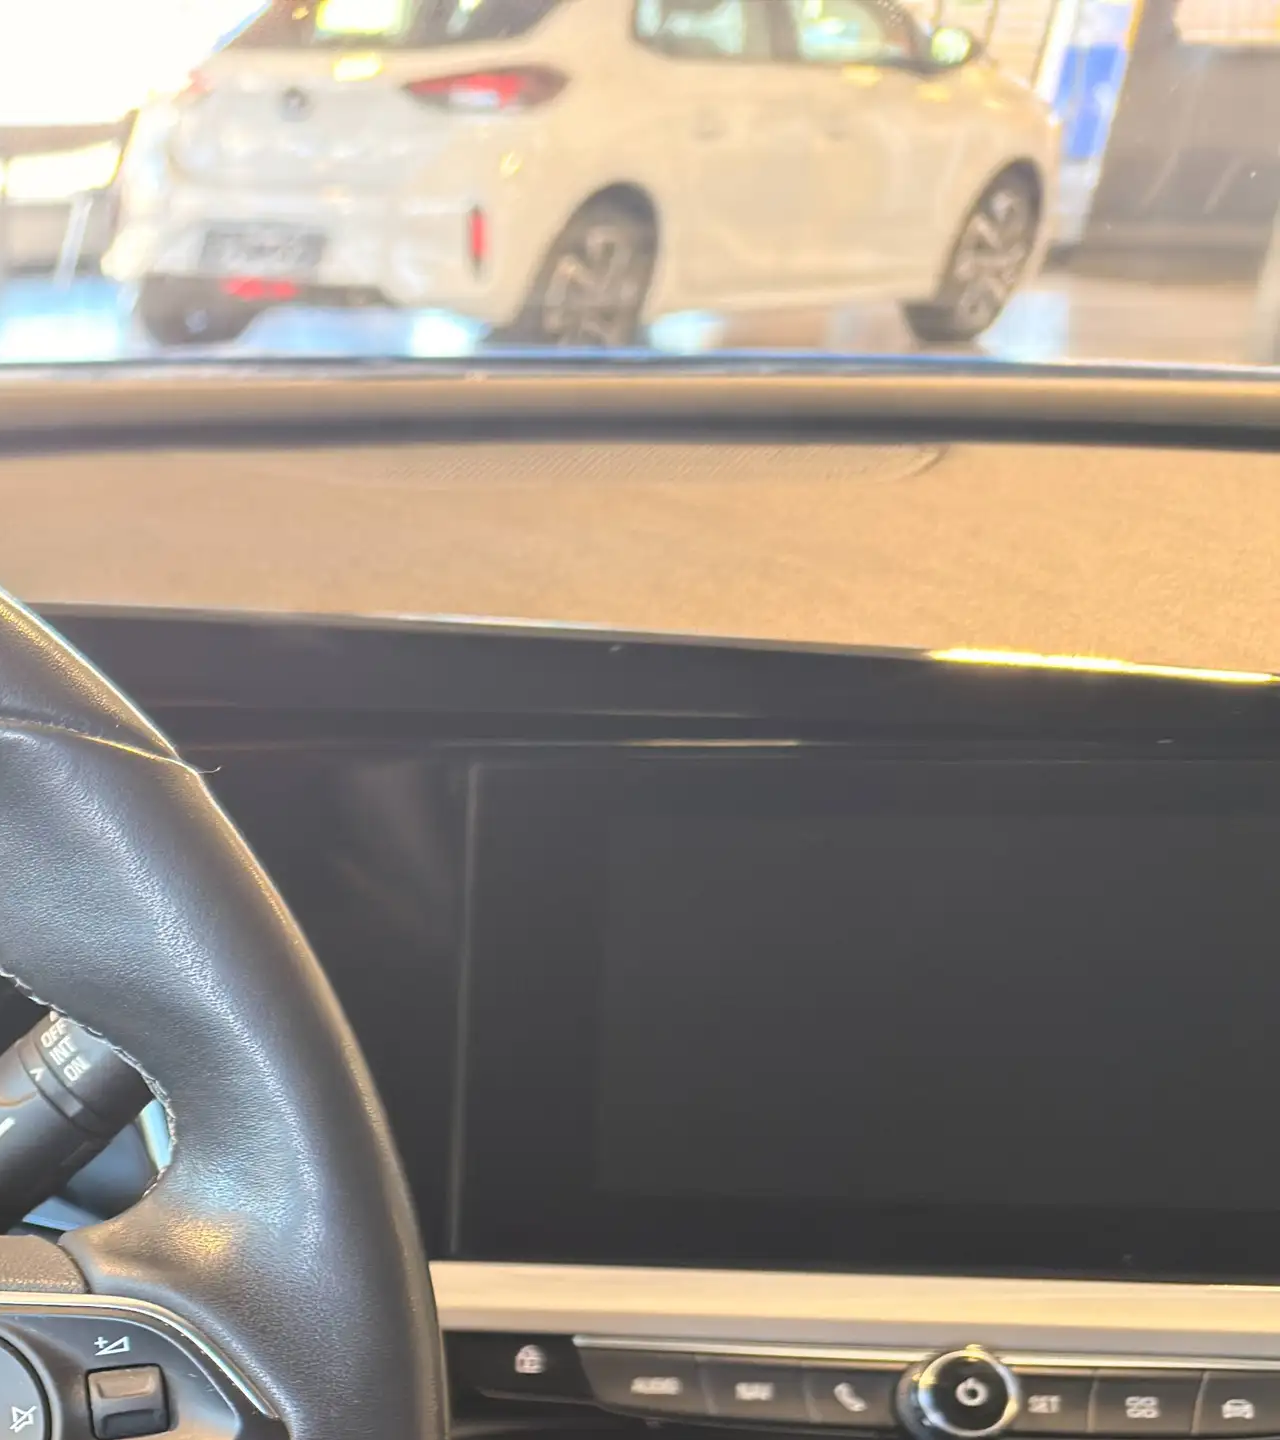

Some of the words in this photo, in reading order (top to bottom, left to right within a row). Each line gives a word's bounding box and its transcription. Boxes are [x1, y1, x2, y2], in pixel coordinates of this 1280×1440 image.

[40, 1017, 69, 1048] OFF
[48, 1035, 78, 1066] INT
[63, 1055, 92, 1082] ON
